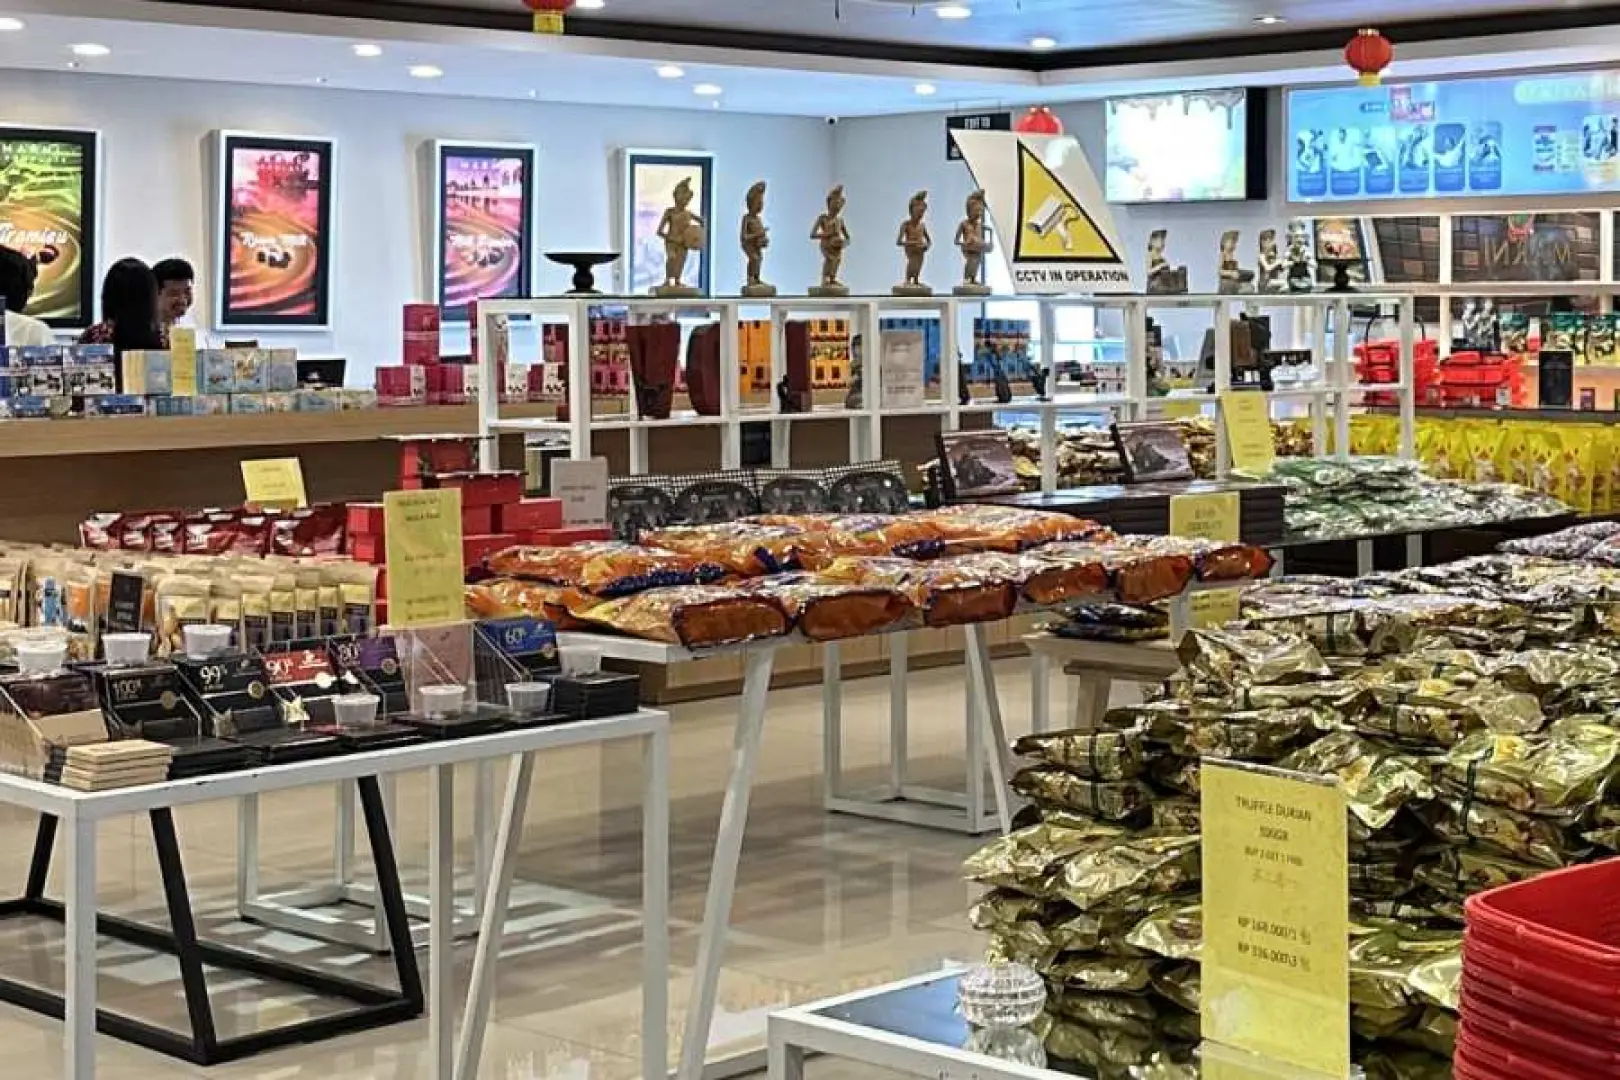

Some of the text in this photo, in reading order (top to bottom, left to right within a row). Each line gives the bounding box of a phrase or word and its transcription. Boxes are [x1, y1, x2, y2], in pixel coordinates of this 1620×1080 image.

[1016, 269, 1129, 281] CCTV IN OPERATION
[1235, 795, 1312, 821] TRUFFLE DURIAN
